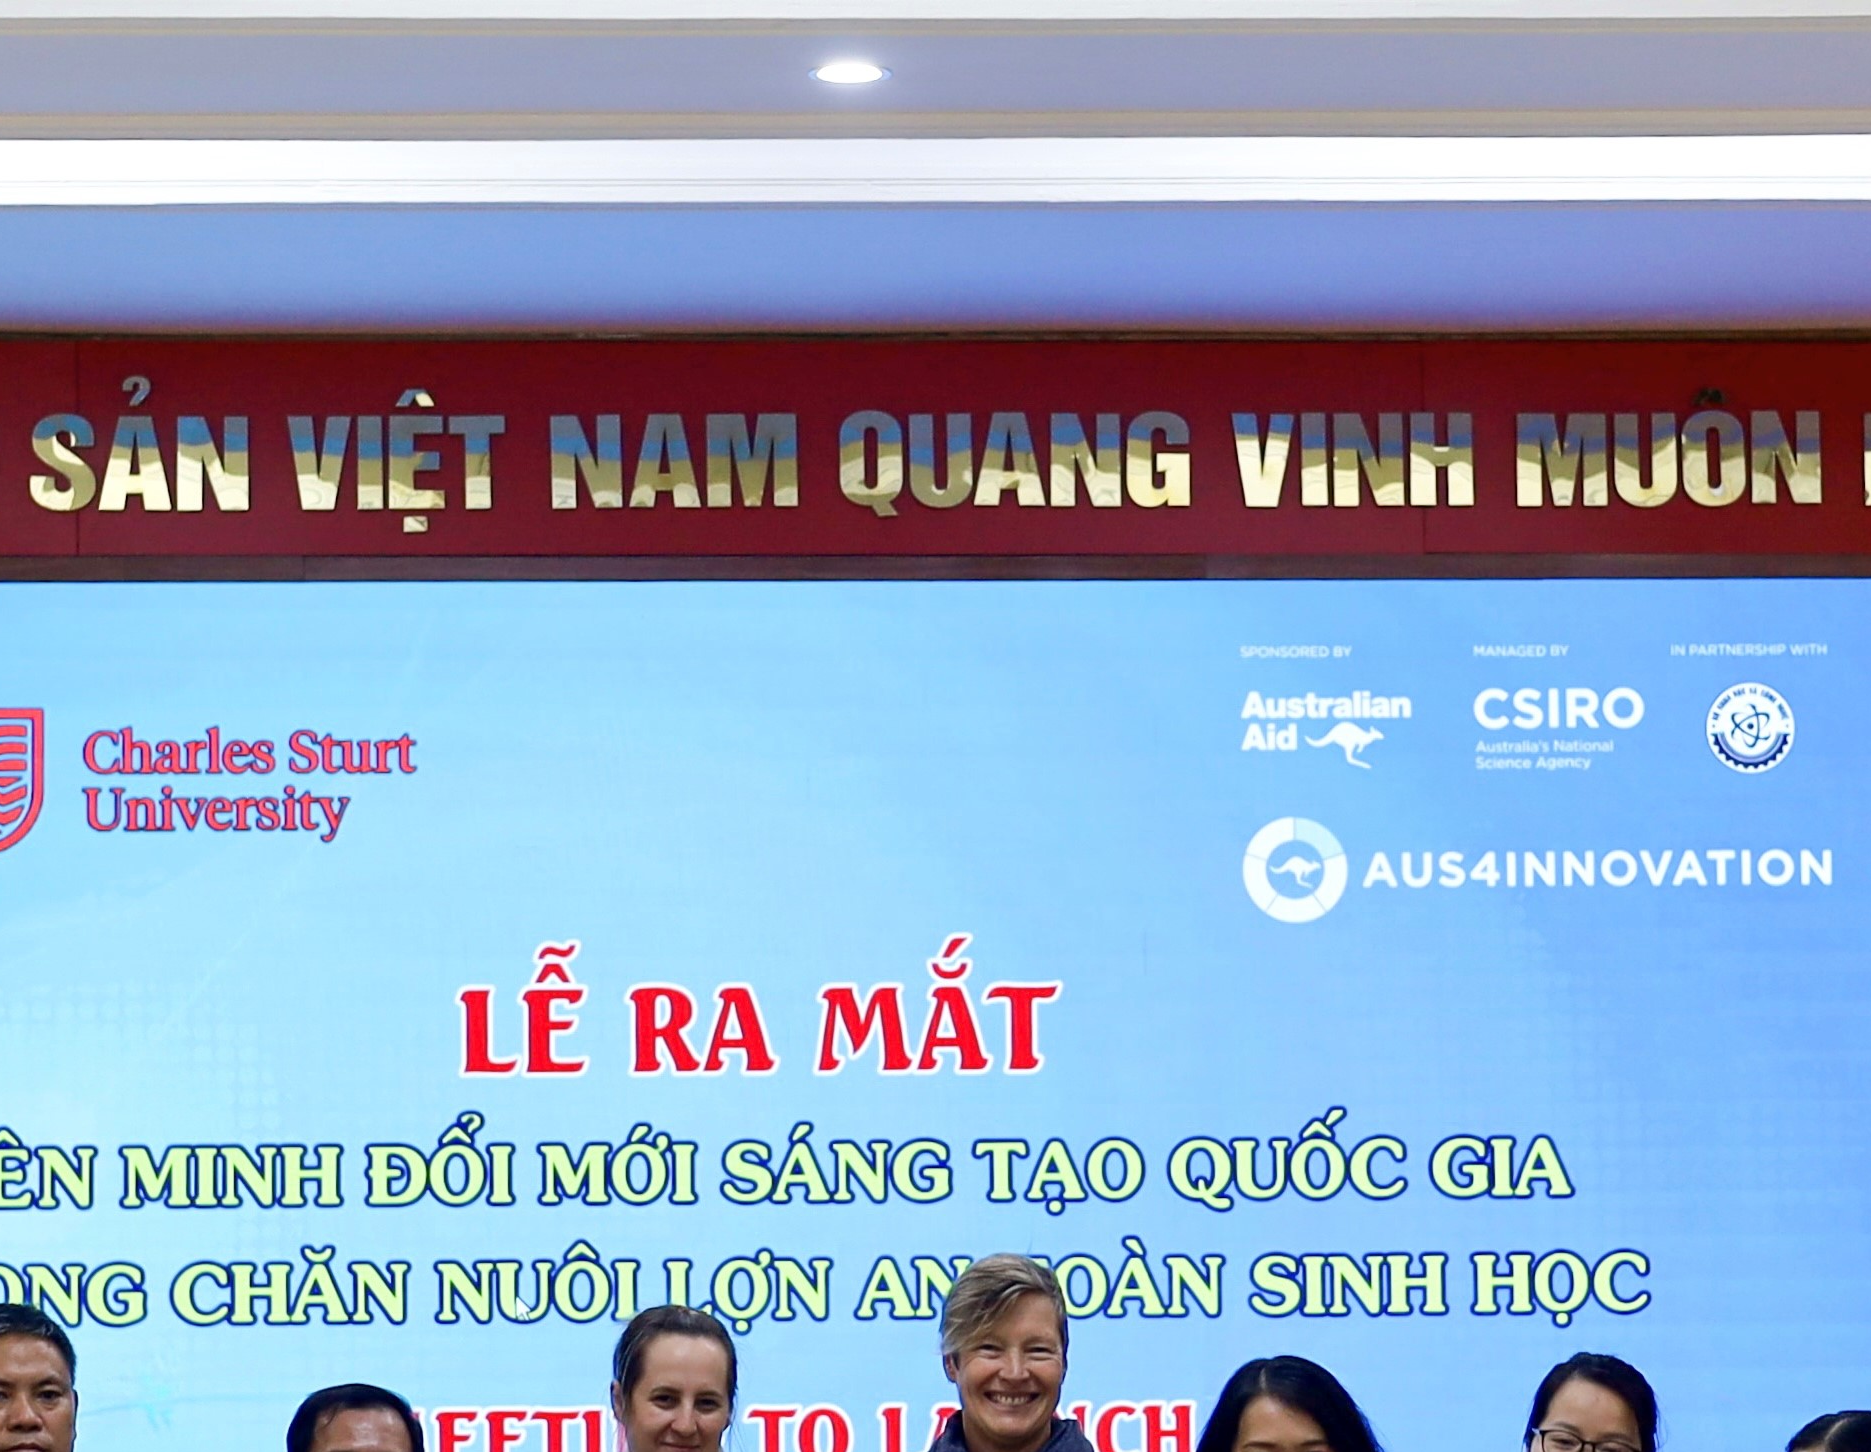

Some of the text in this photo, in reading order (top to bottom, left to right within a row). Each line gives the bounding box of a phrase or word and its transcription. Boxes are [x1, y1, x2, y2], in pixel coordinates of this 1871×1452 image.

[29, 375, 250, 512] SẢN
[287, 388, 506, 532] VIỆT
[549, 413, 800, 509] NAM
[839, 410, 1191, 517] QUANG
[1232, 412, 1475, 508] VINH
[1516, 387, 1822, 508] MUÔN
[1240, 645, 1352, 658] SPONSORED BY
[1473, 644, 1569, 657] MANAGED BY
[1670, 643, 1828, 656] IN PARTNERSHIP WITH
[1241, 691, 1412, 719] Australian
[1472, 686, 1646, 731] CSIRO
[83, 727, 417, 775] Charles Sturt
[1241, 722, 1298, 751] Aid
[1475, 739, 1615, 753] Australia's National
[1475, 756, 1591, 771] Science Agency
[82, 786, 349, 843] University
[1362, 849, 1834, 888] AUS4INNOVATION
[457, 935, 1060, 1075] LỄ RA MẮT
[119, 1143, 345, 1209] MINH
[365, 1110, 517, 1208] ĐỔI
[537, 1123, 699, 1206] MỚI
[721, 1121, 954, 1205] SÁNG
[972, 1136, 1146, 1215] TẠO
[1168, 1106, 1408, 1214] QUỐC
[1429, 1134, 1576, 1202] GIA
[169, 1244, 412, 1327] CHĂN
[433, 1238, 640, 1324] NUÔI
[663, 1247, 834, 1335] LỢN
[853, 1255, 974, 1322] AN
[1030, 1235, 1225, 1320] OÀN
[1250, 1251, 1449, 1319] SINH
[1472, 1248, 1653, 1329] HỌC
